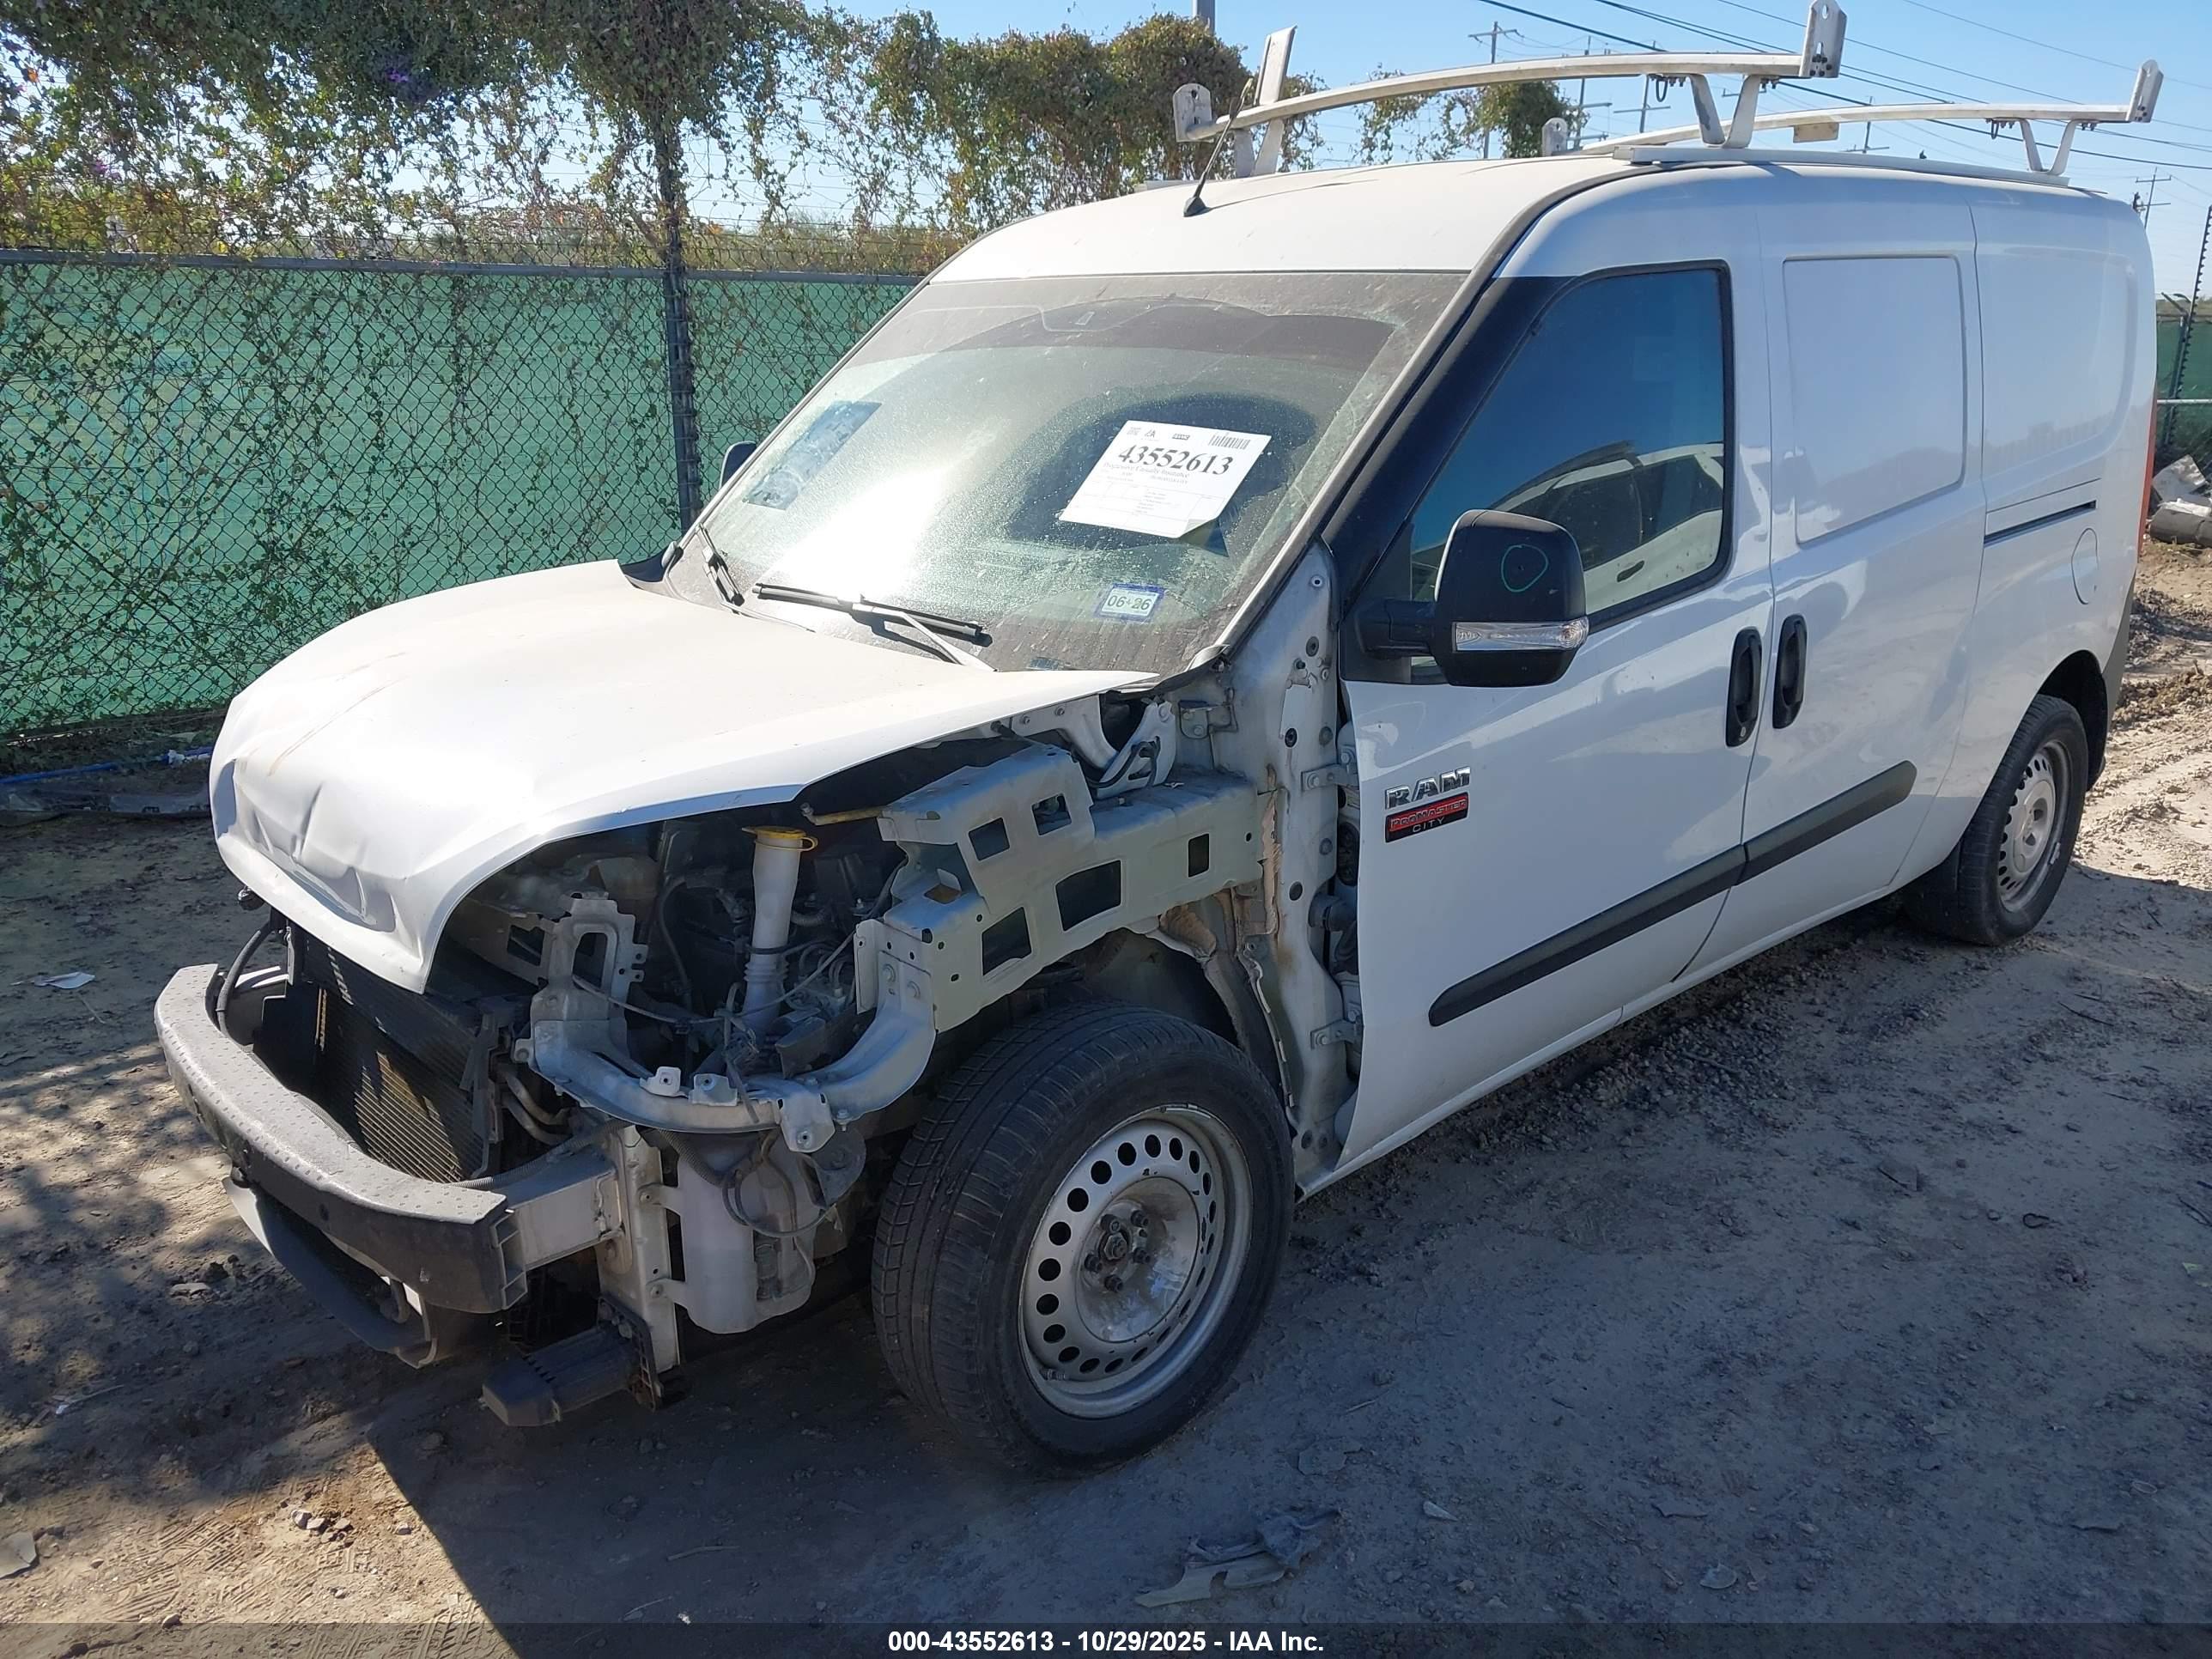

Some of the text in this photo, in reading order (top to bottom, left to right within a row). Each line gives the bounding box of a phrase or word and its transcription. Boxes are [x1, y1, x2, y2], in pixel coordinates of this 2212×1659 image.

[1118, 444, 1234, 476] 43552613
[1384, 766, 1471, 810] RAM
[1413, 817, 1445, 833] CITY
